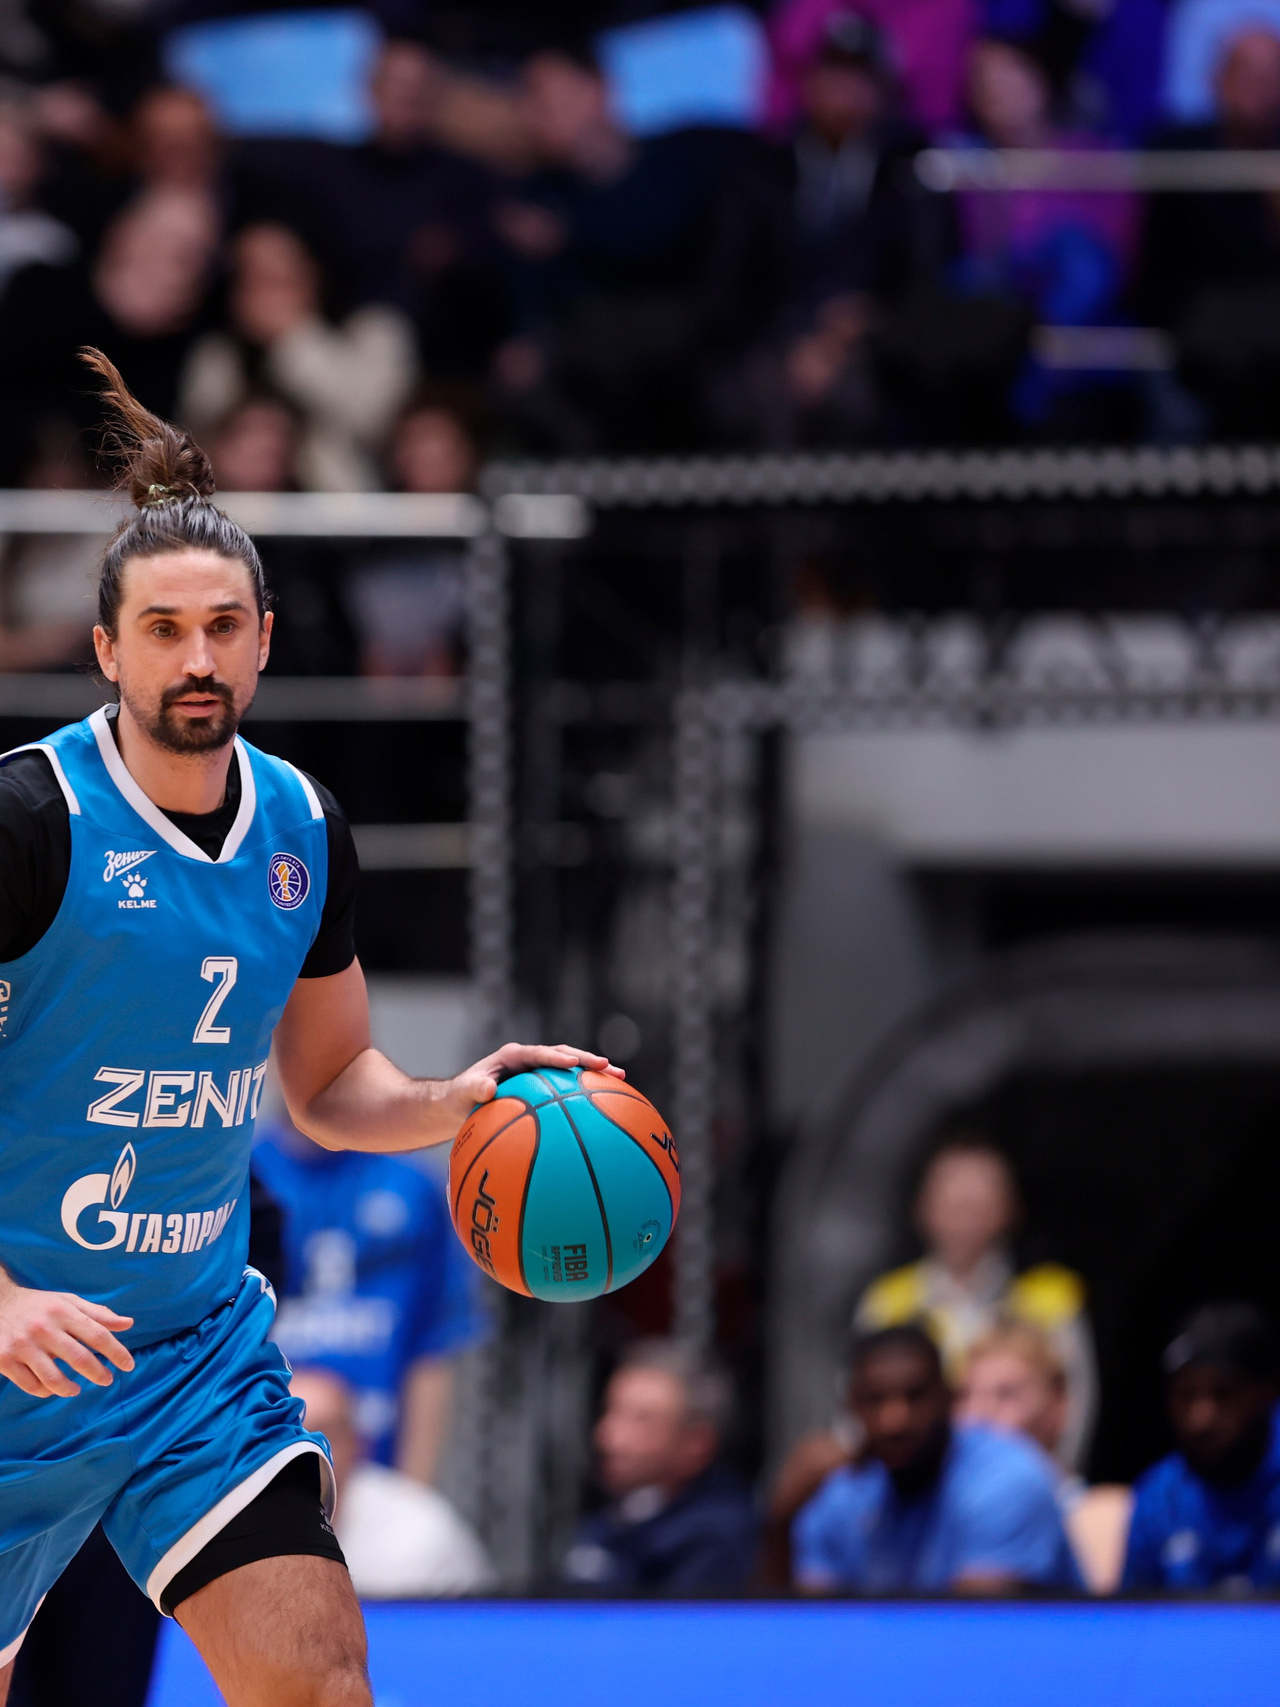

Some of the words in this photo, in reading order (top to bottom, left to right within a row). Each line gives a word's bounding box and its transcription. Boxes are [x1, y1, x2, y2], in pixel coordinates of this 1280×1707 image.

[118, 899, 158, 909] KELME
[192, 956, 238, 1044] 2
[86, 1058, 268, 1129] ZENIT
[471, 1168, 501, 1282] JÖGE
[562, 1243, 590, 1282] FIBA
